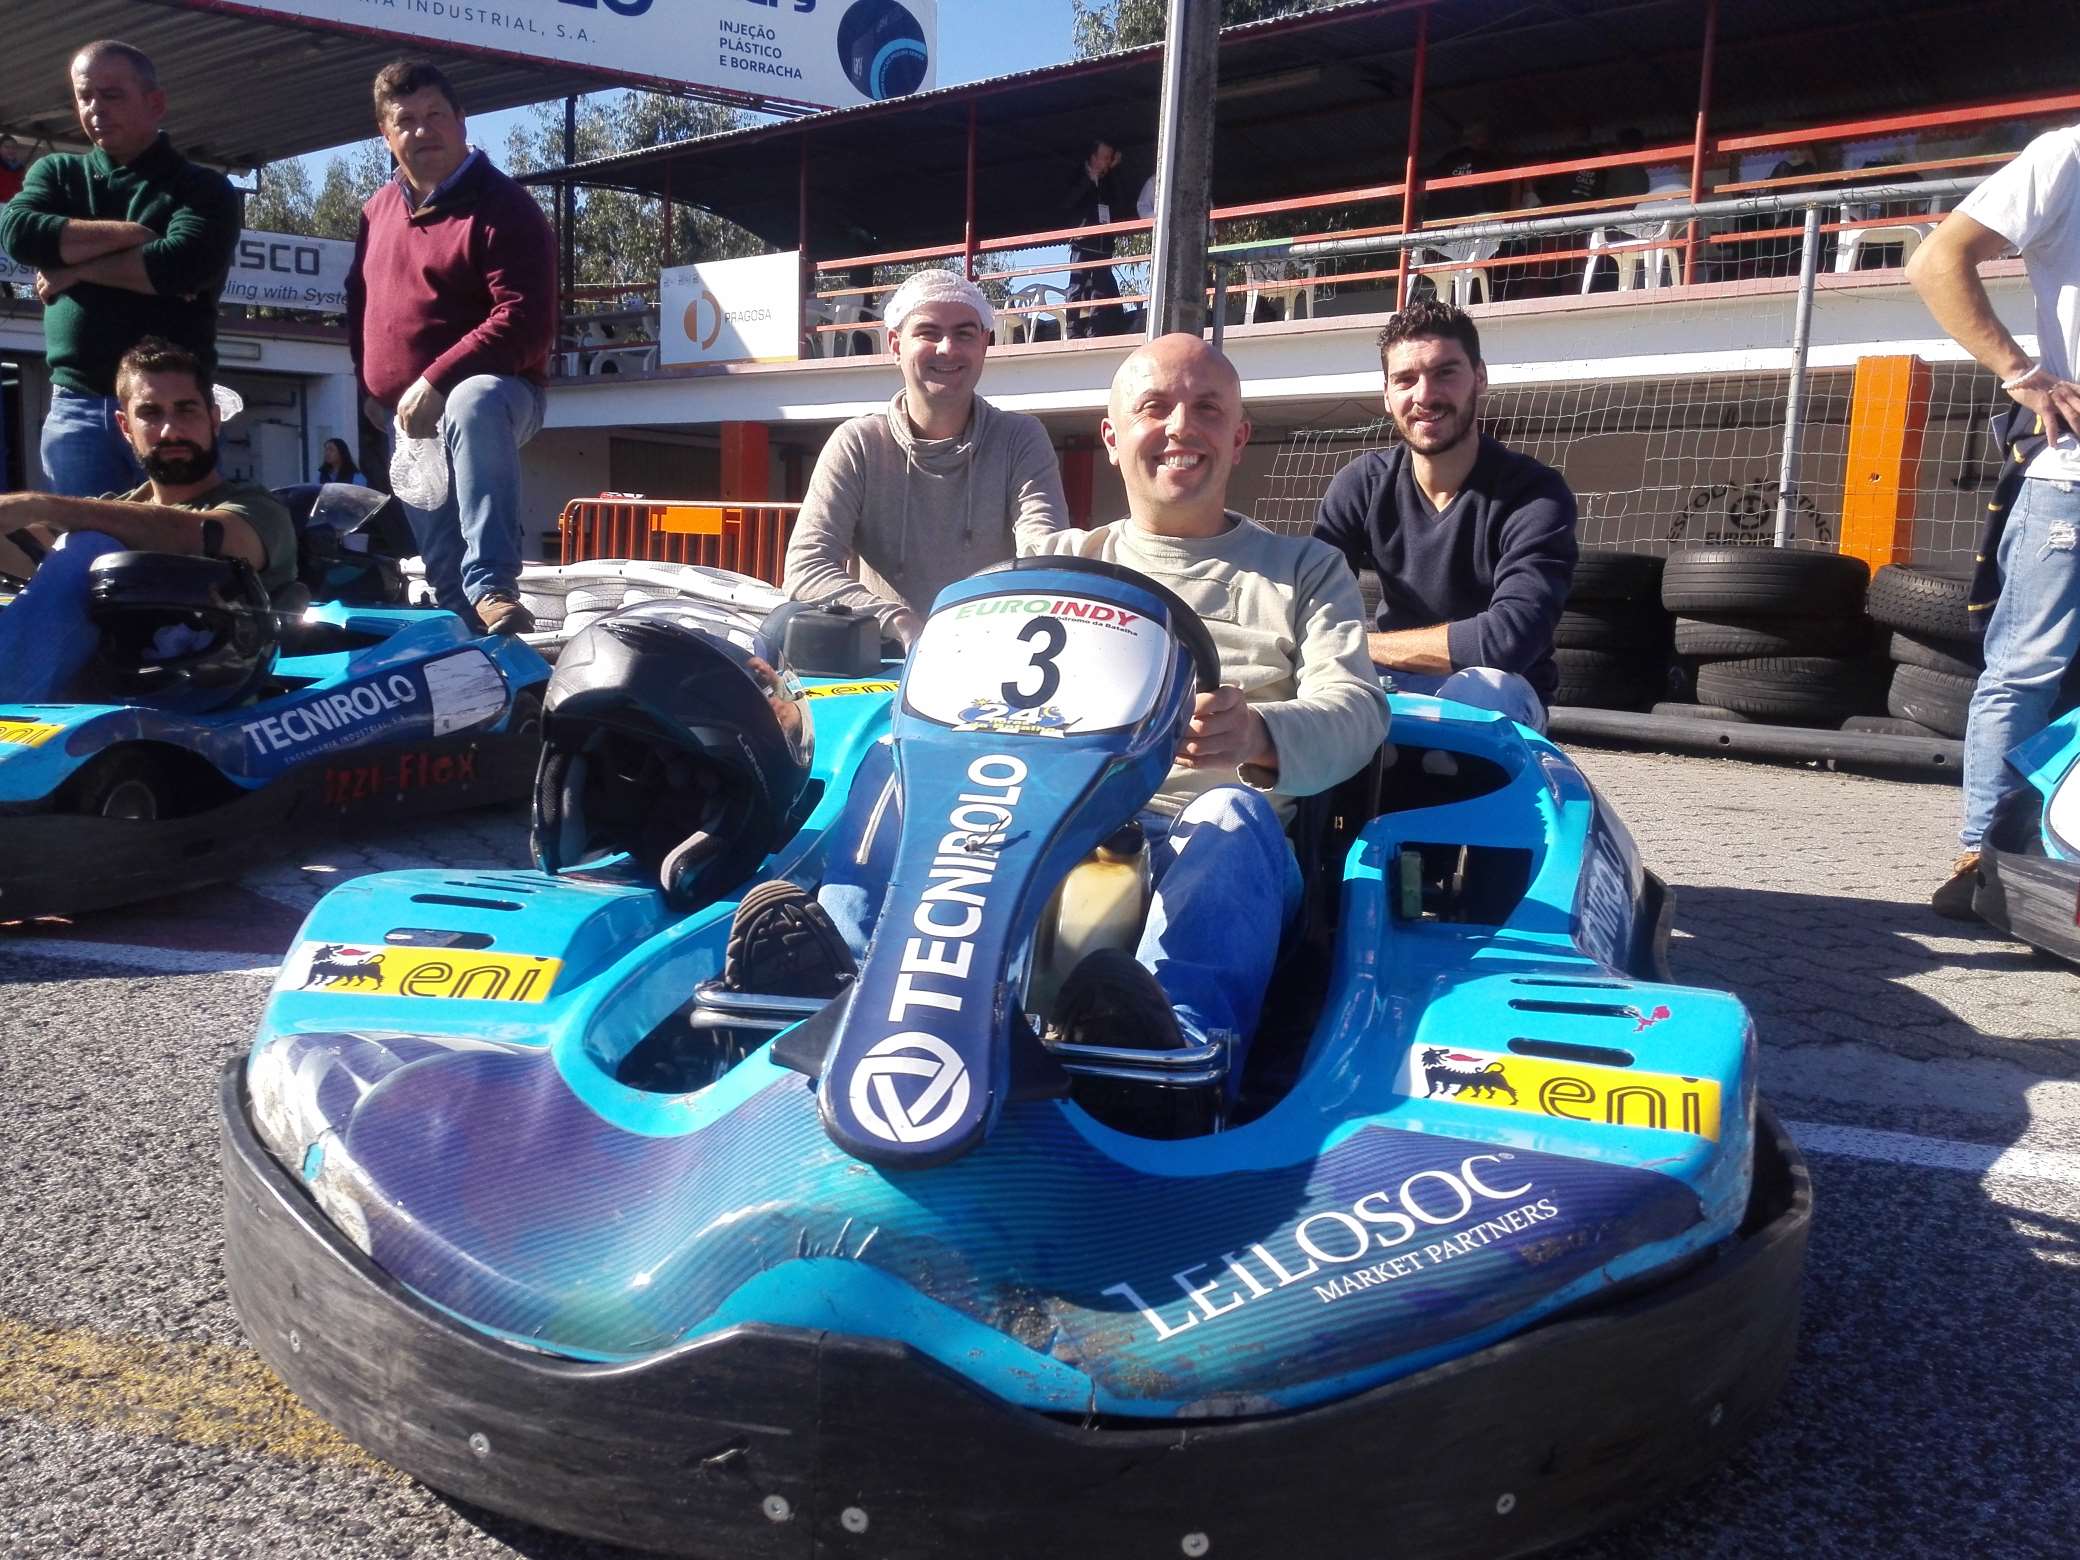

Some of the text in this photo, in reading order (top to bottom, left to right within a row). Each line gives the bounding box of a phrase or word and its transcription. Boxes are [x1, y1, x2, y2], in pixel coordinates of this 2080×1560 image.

[407, 0, 545, 36] INDUSTRIAL,
[556, 24, 597, 43] S.A.
[719, 19, 775, 40] INJEÇÃO
[719, 37, 782, 59] PLÁSTICO
[719, 54, 802, 80] E BORRACHA
[264, 285, 298, 300] with
[724, 309, 772, 324] PRAGOSA
[955, 599, 1141, 627] EUROINDY
[1001, 616, 1067, 709] 3
[241, 674, 417, 755] TECNIROLO
[888, 754, 1028, 1025] TECNIROLO
[399, 954, 549, 1002] eni
[1538, 1074, 1701, 1134] eni
[1312, 1197, 1559, 1304] MARKET PARTNERS
